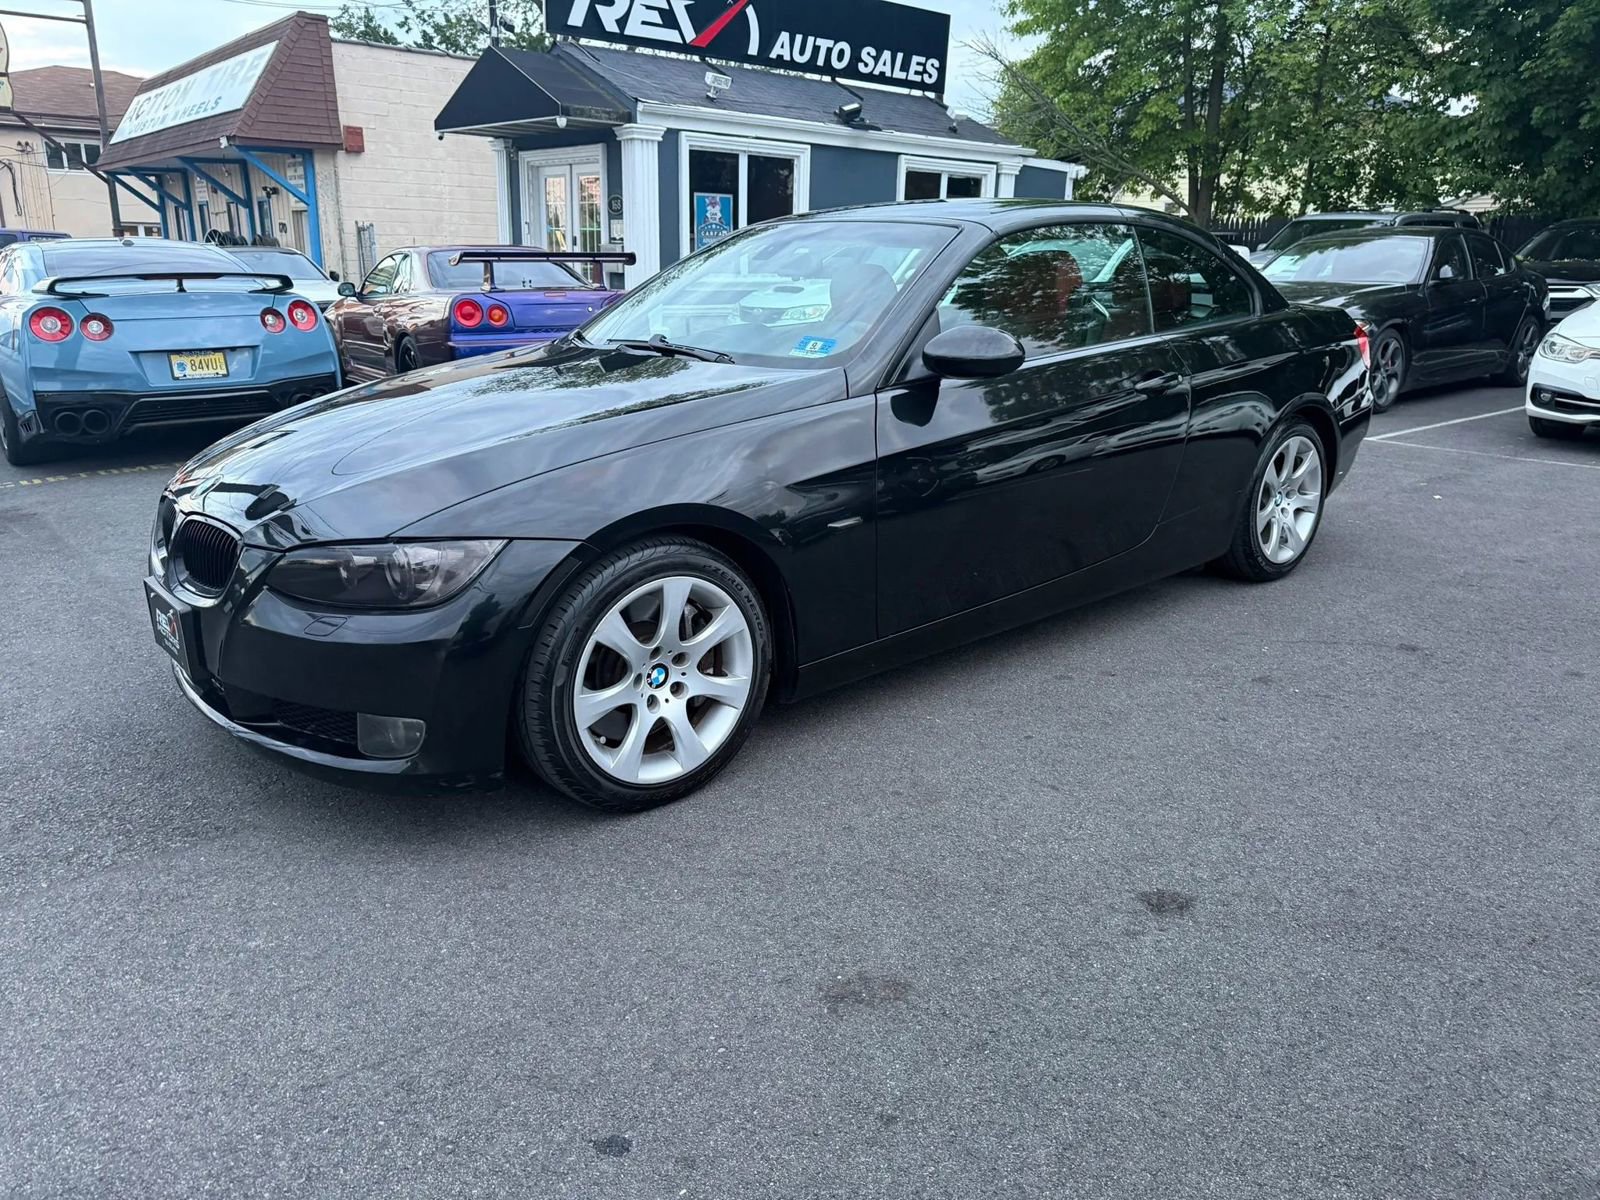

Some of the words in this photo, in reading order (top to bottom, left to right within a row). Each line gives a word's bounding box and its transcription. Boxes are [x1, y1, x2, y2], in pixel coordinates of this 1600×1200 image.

[769, 31, 851, 69] AUTO
[858, 46, 940, 84] SALES
[126, 79, 197, 122] ACTION
[201, 51, 268, 94] TIRE
[171, 96, 222, 121] WHEELS
